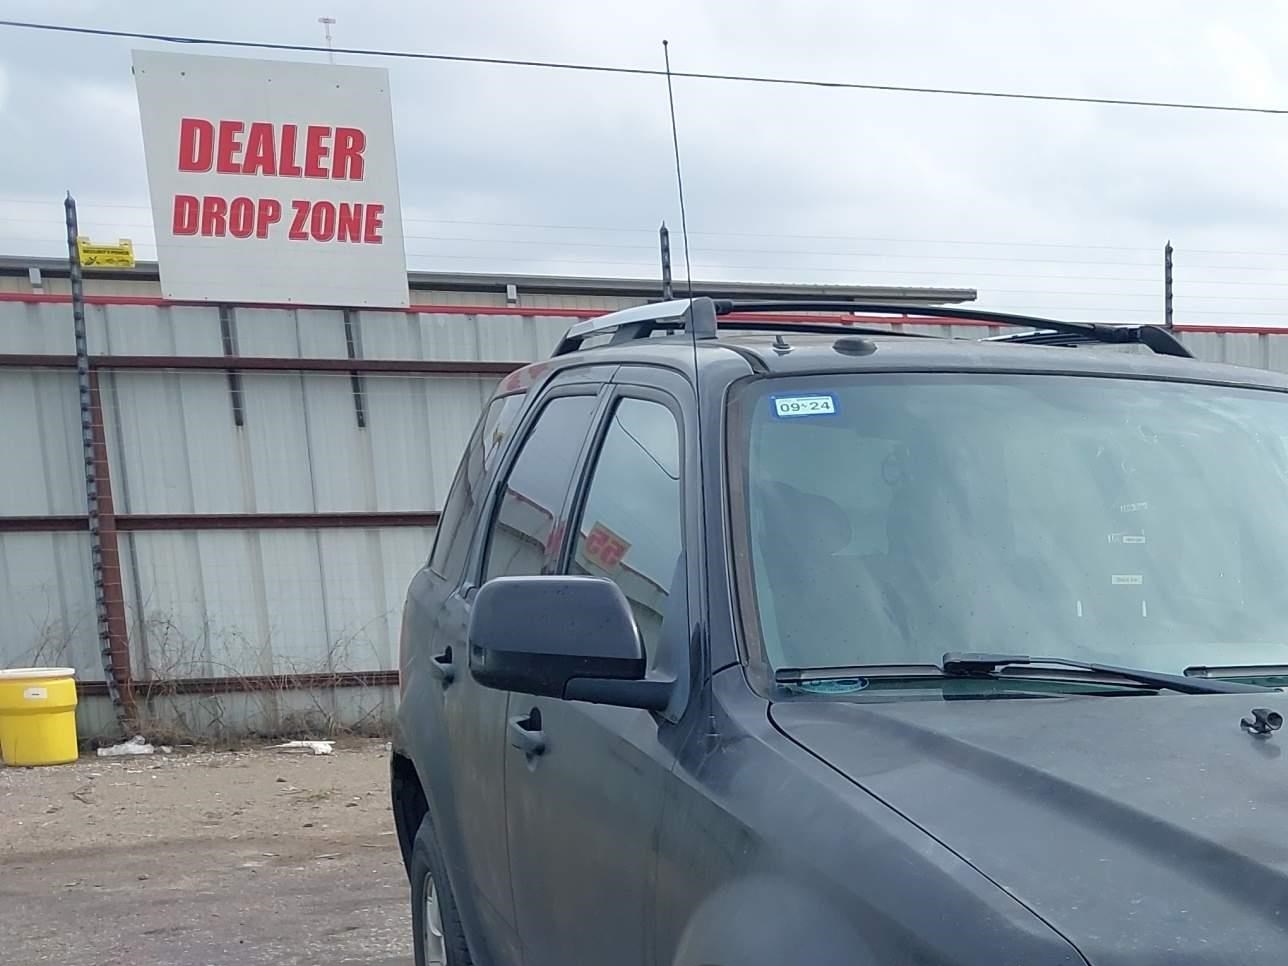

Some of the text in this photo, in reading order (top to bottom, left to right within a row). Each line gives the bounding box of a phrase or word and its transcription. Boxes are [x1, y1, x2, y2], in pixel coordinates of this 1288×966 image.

[178, 118, 367, 181] DEALER
[172, 194, 385, 245] DROP ZONE
